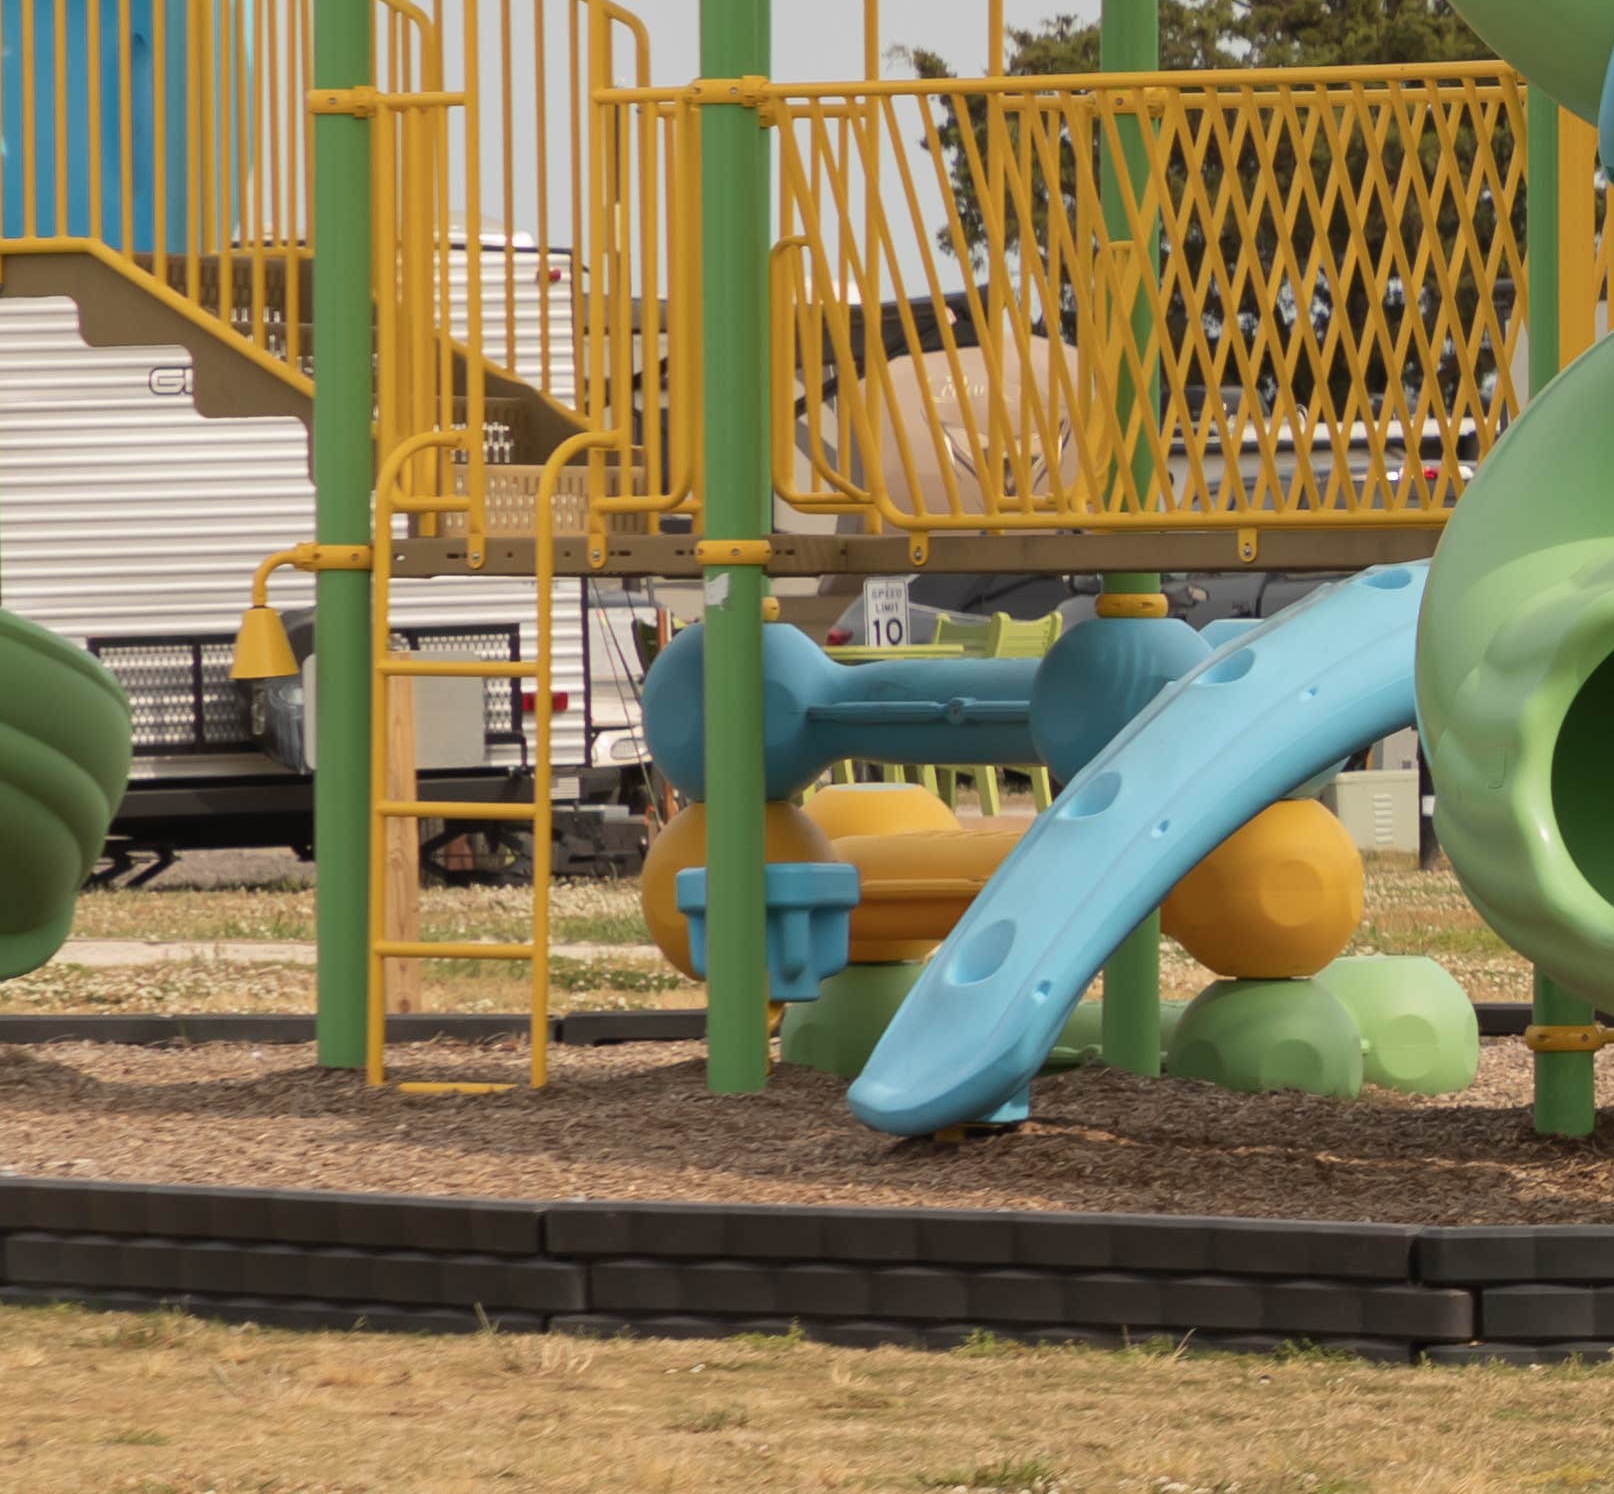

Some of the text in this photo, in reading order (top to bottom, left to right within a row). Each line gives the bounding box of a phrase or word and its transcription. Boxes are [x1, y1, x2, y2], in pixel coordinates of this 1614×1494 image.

[148, 365, 193, 396] G
[871, 588, 902, 600] SPEED
[875, 602, 899, 613] LIMIT
[873, 617, 903, 647] 10
